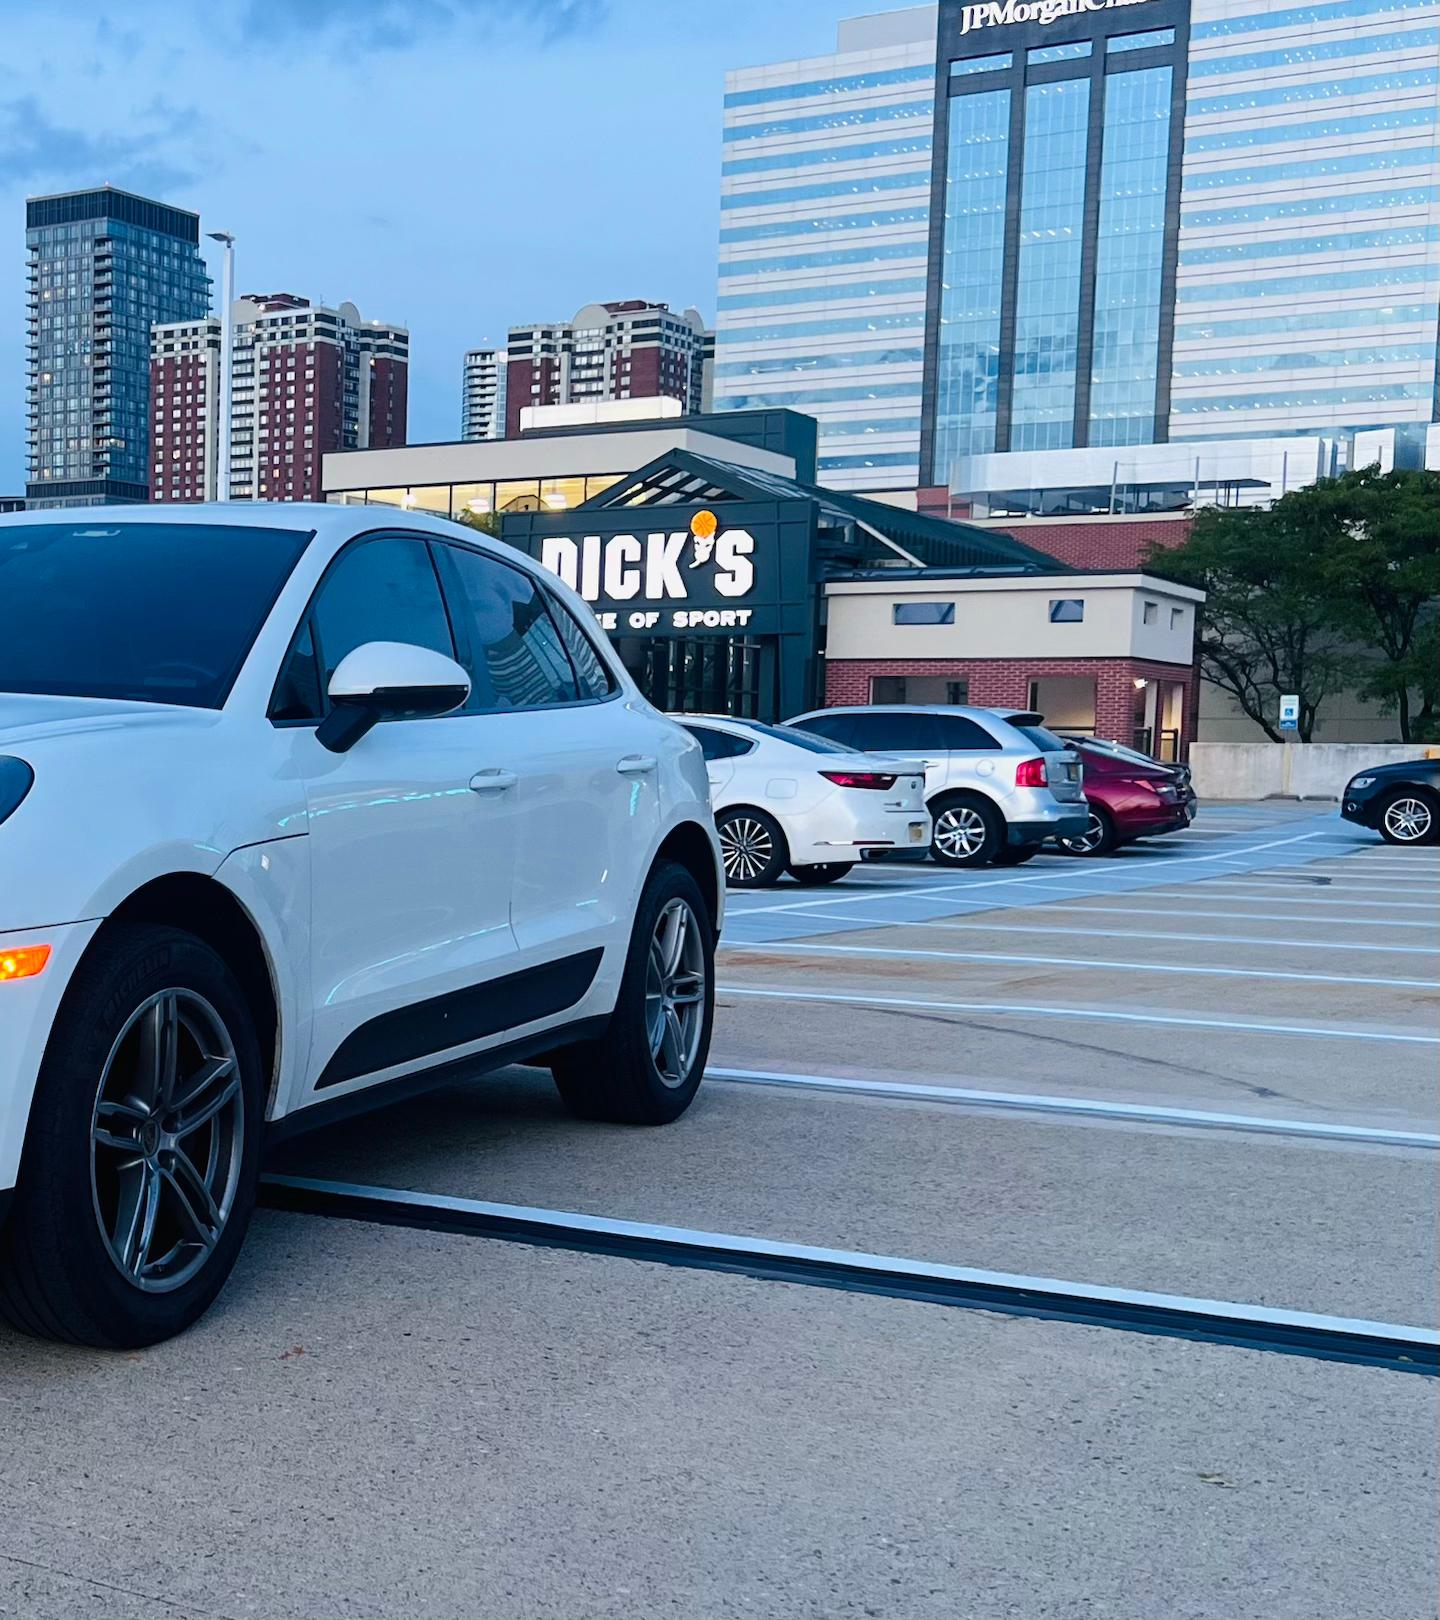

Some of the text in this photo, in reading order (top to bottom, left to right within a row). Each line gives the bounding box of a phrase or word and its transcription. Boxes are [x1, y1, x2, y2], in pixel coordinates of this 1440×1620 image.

[960, 0, 1148, 35] JPMorgan
[541, 529, 755, 601] DICK'S
[628, 611, 660, 629] OF
[672, 609, 753, 628] SPORT
